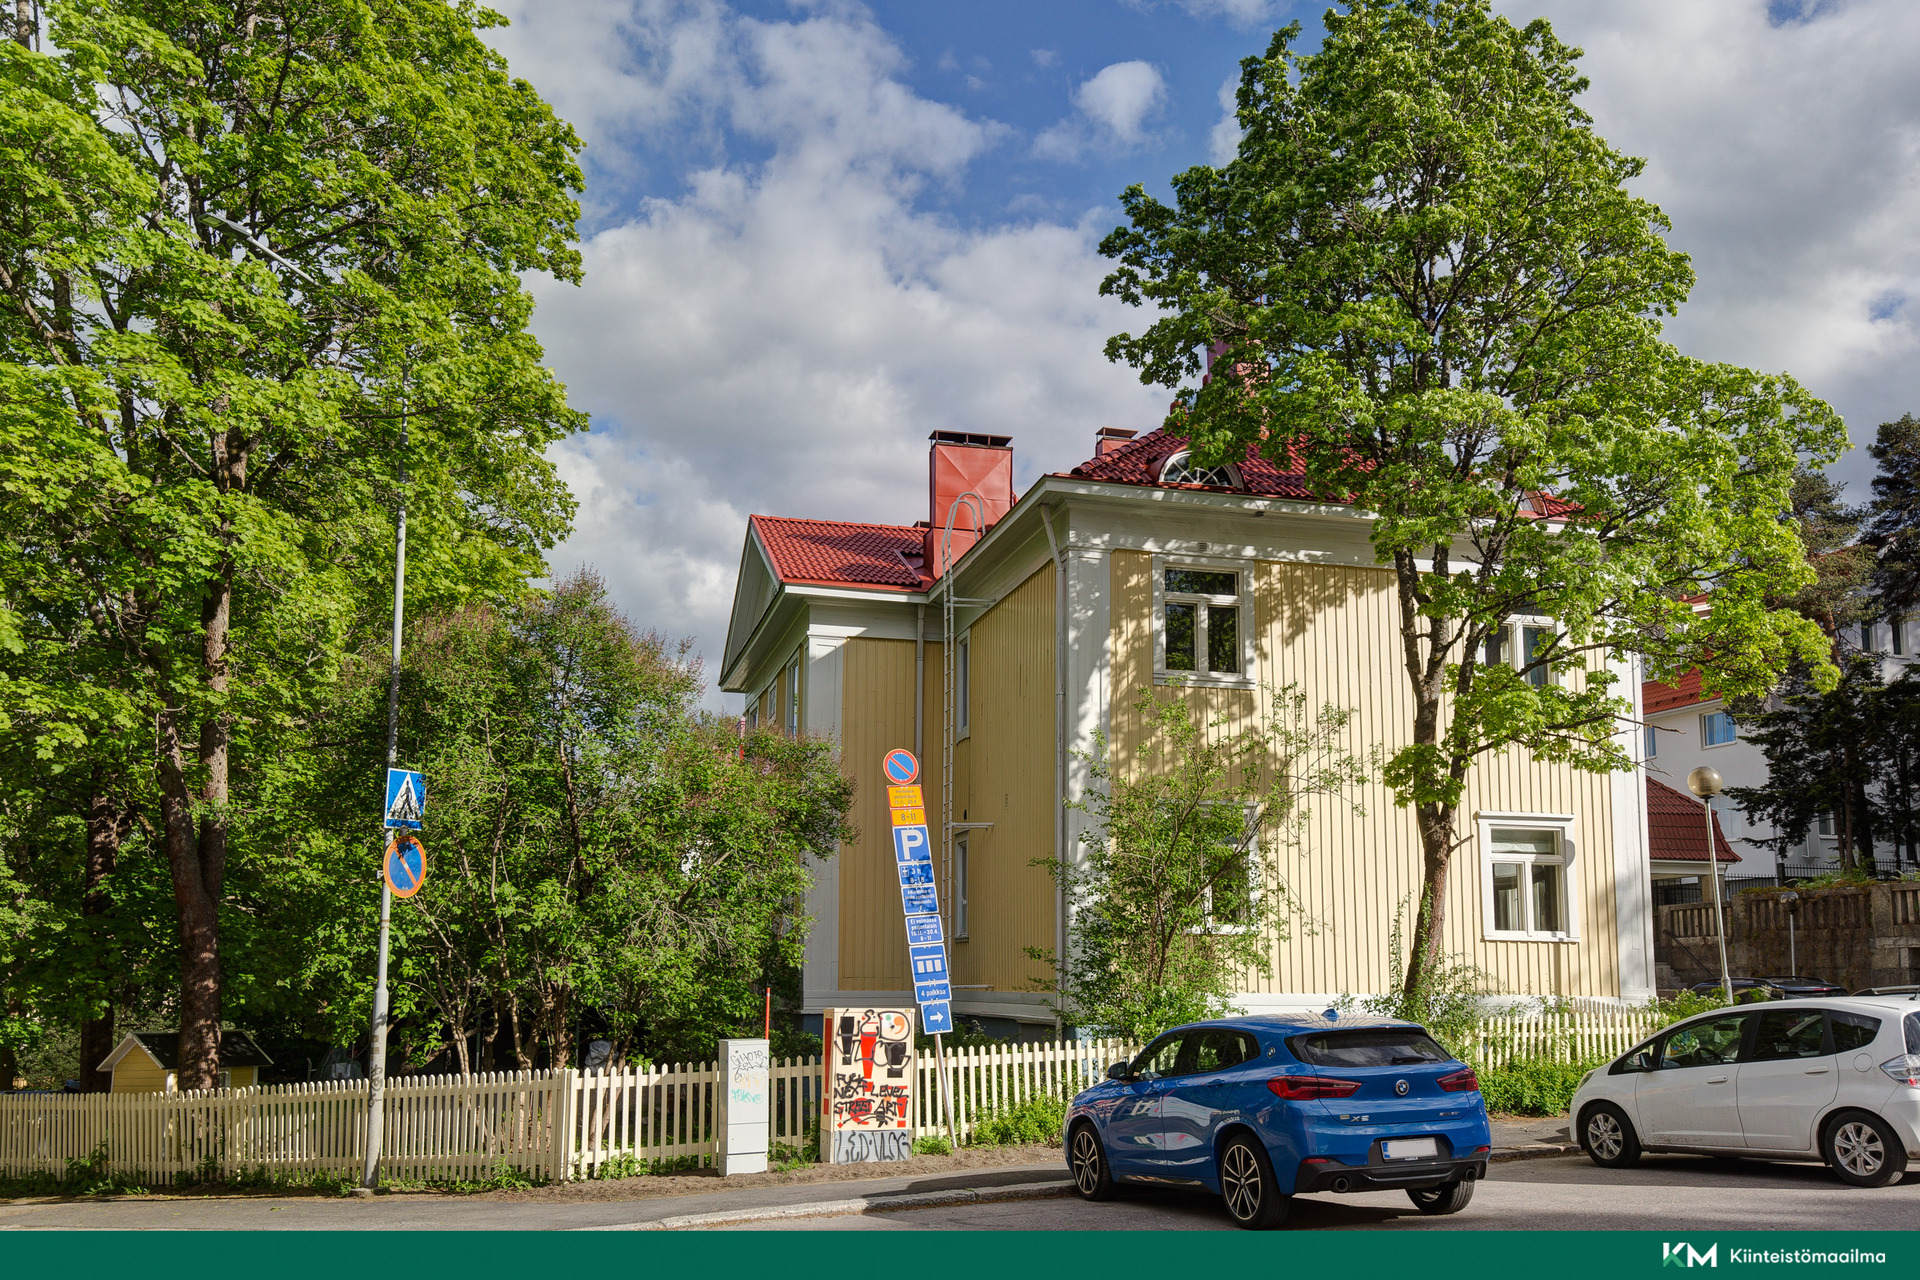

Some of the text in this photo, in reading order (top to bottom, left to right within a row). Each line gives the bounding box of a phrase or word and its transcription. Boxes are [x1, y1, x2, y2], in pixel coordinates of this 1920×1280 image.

[901, 829, 924, 860] P
[926, 989, 946, 997] paikkaa
[834, 1084, 868, 1099] NEXT
[834, 1099, 875, 1115] STREET
